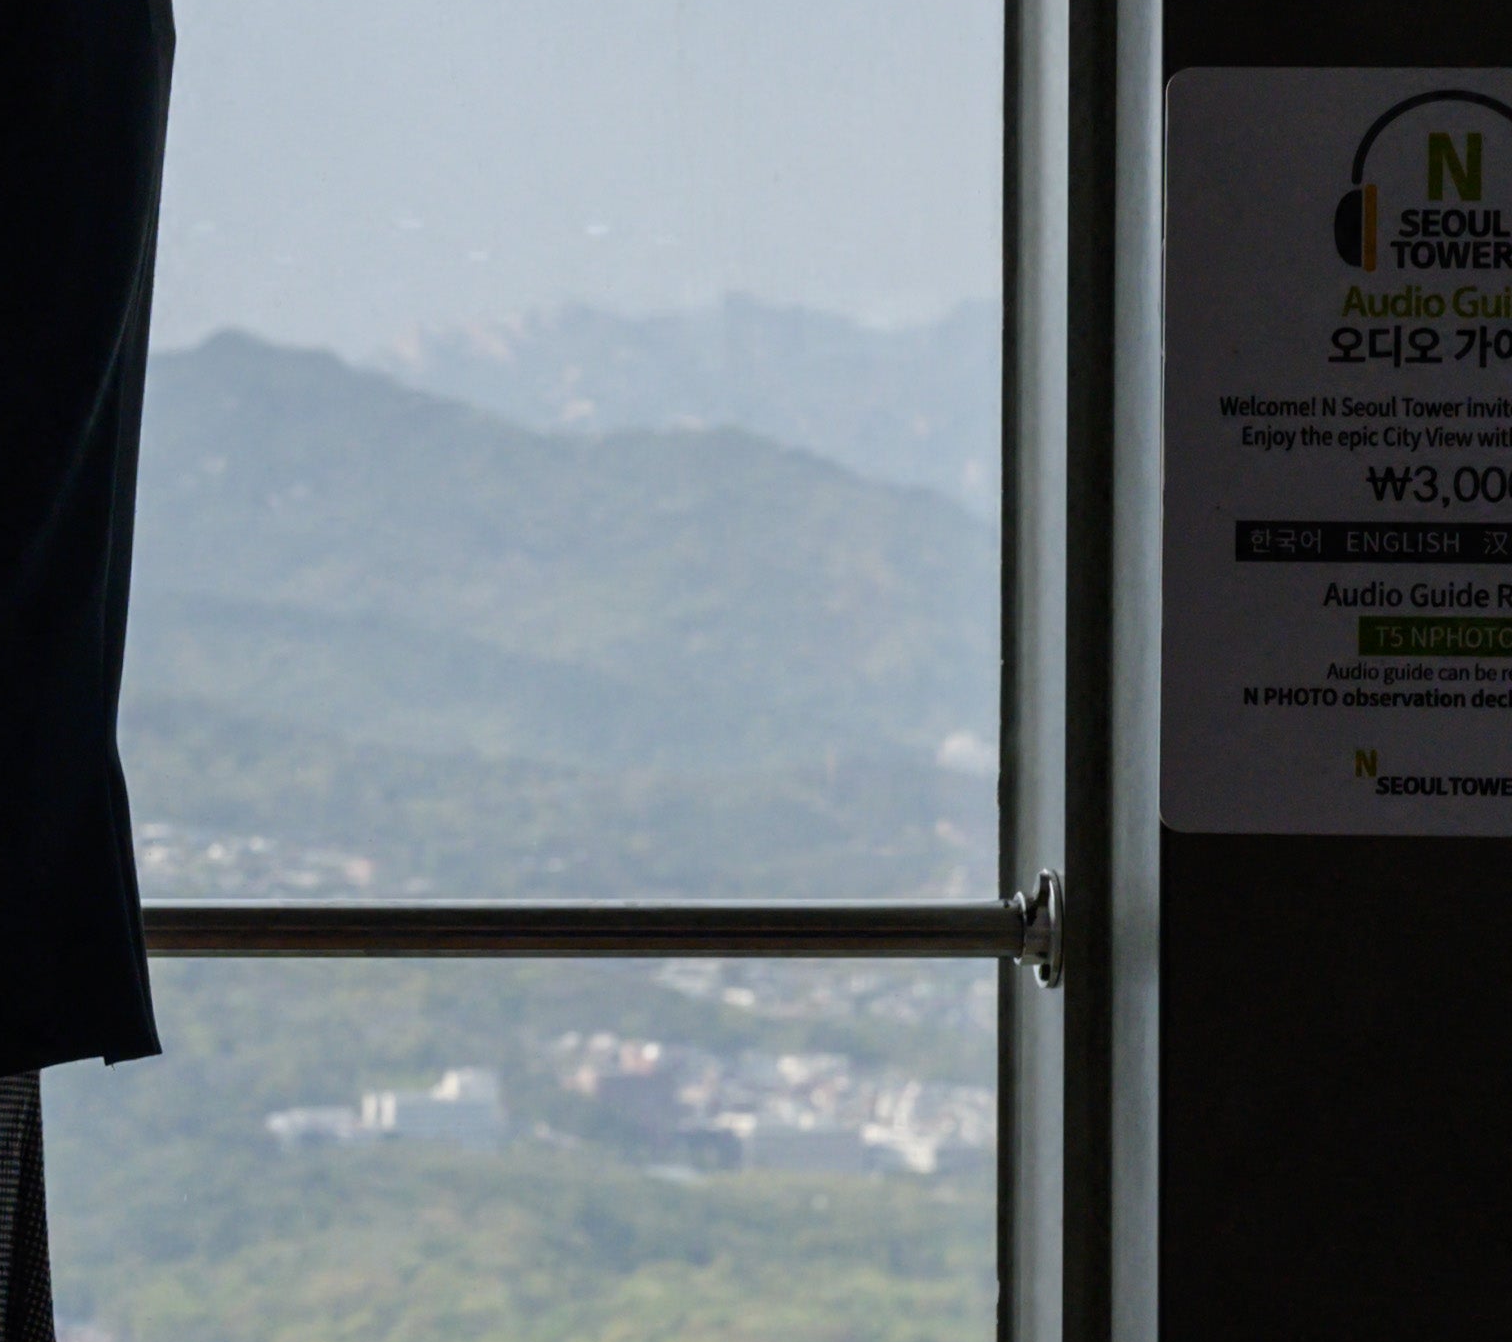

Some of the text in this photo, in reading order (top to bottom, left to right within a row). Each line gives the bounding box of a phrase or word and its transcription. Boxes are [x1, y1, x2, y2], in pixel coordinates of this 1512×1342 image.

[1428, 132, 1483, 202] N
[1399, 208, 1511, 239] SEOUL
[1391, 240, 1512, 270] TOWER
[1342, 285, 1446, 319] Audio
[1328, 325, 1443, 369] 오디오
[1220, 395, 1512, 418] Welcome! N Seoul Tower invit
[1242, 425, 1512, 453] Enjoy the epic City View wit
[1366, 465, 1512, 509] ₩3,00
[1250, 527, 1323, 554] 한국어
[1345, 530, 1460, 554] ENGLISH
[1323, 581, 1404, 608] Audio
[1409, 581, 1490, 609] Guide
[1376, 626, 1404, 648] T5
[1327, 662, 1380, 681] Audio
[1384, 663, 1435, 686] guide
[1439, 667, 1471, 682] can
[1475, 663, 1498, 682] be
[1243, 687, 1512, 709] N PHOTO observation dec
[1355, 749, 1378, 777] N
